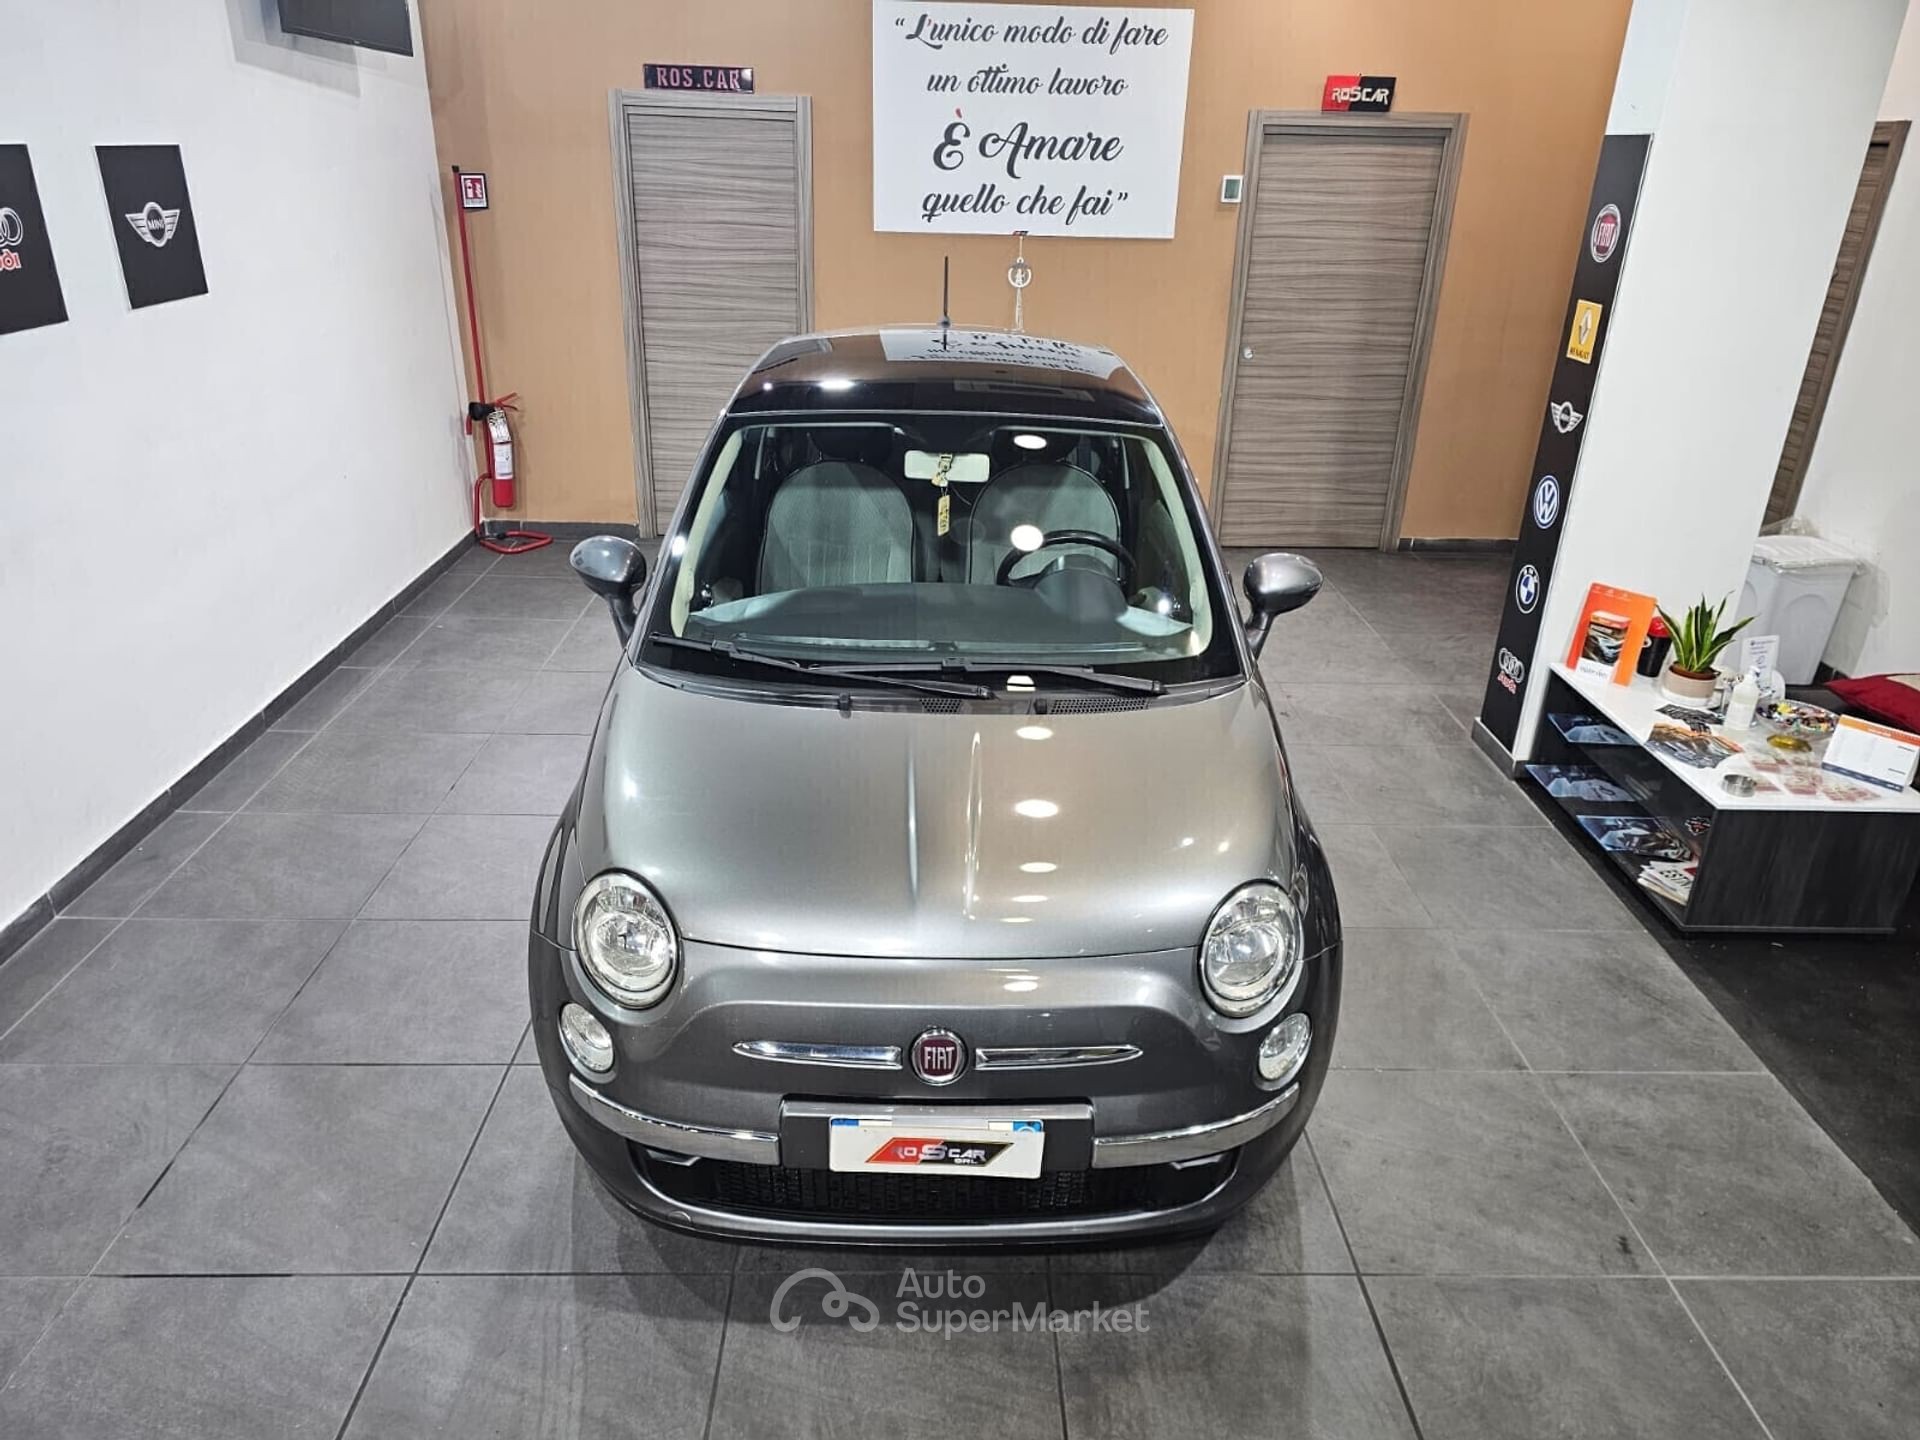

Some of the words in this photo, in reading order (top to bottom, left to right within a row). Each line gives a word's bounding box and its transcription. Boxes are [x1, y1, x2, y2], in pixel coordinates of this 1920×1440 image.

[1003, 16, 1076, 45] modo
[1081, 17, 1111, 45] di
[1110, 17, 1169, 55] fare
[927, 73, 961, 93] un
[967, 63, 1043, 94] ottimo
[1048, 67, 1129, 96] lavoro
[1332, 86, 1389, 105] ROSCAR
[933, 107, 971, 171] È
[978, 122, 1124, 179] Amare
[922, 183, 1010, 223] quello
[1016, 184, 1065, 215] che
[924, 1047, 955, 1070] FIAT
